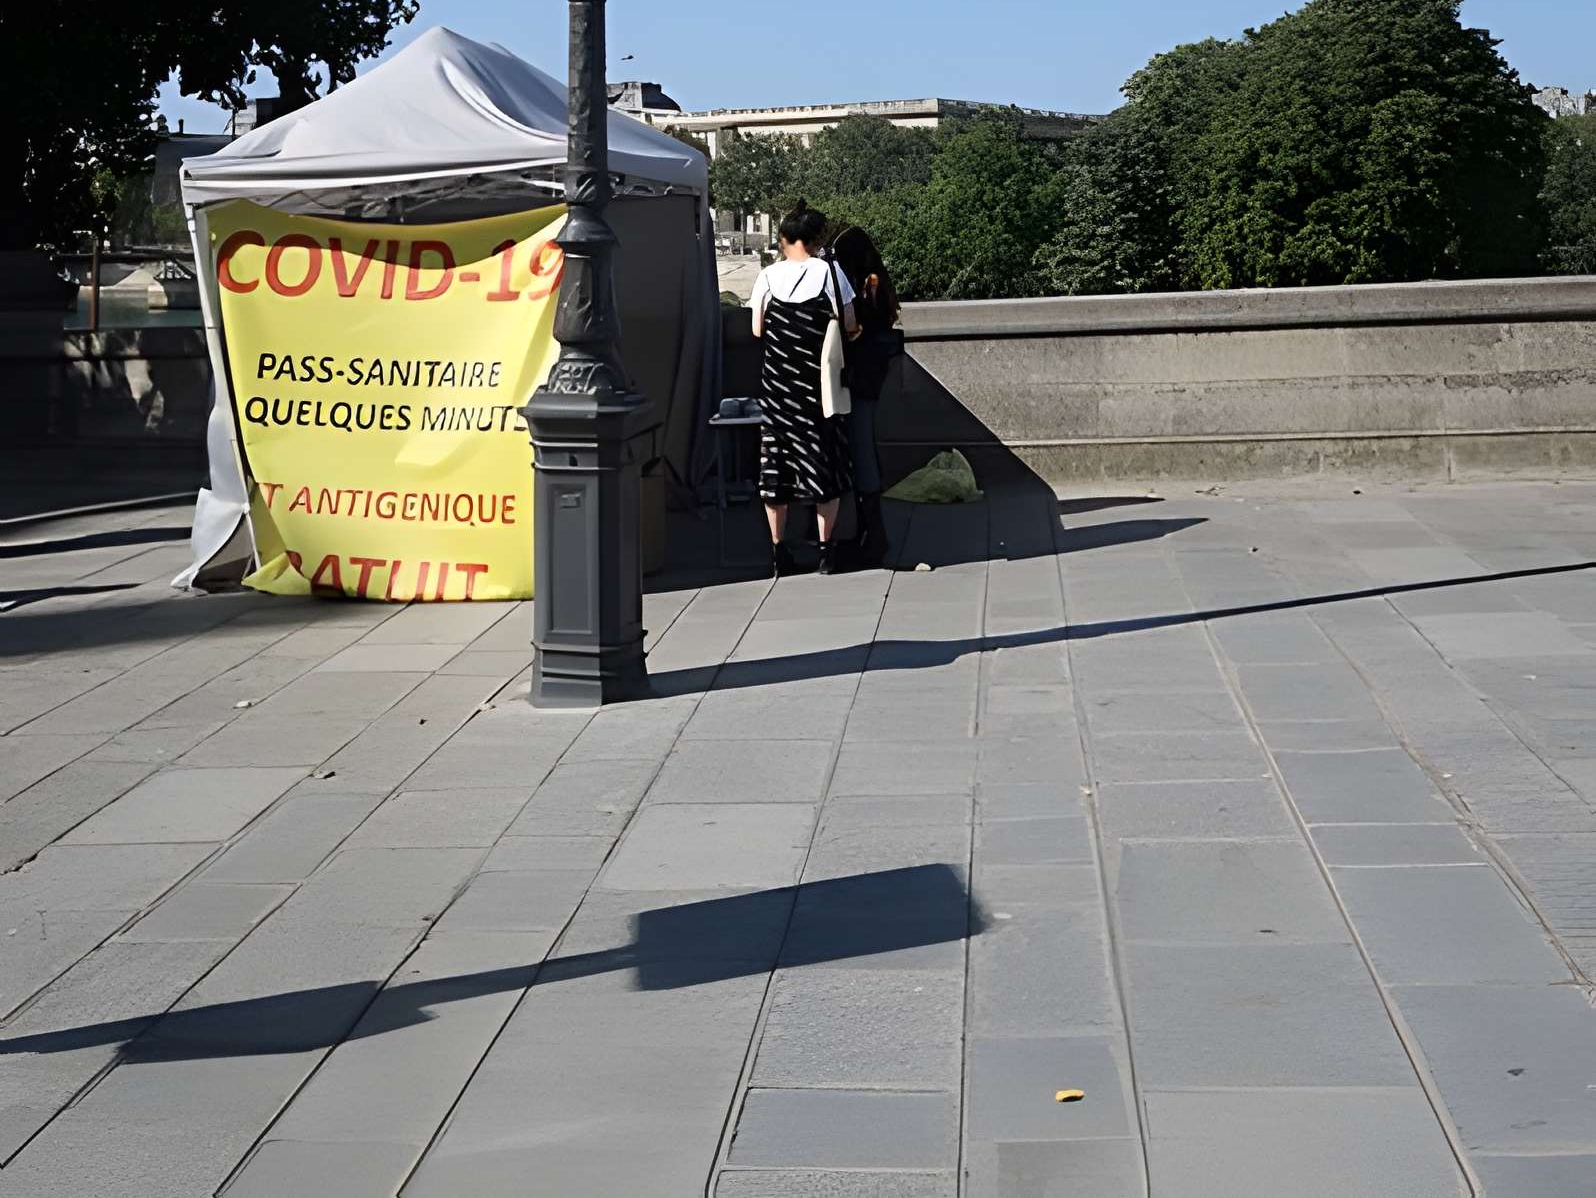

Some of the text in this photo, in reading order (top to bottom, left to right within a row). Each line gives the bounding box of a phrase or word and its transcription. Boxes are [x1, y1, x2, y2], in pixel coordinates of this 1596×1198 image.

[256, 352, 502, 387] PASS-SANITAIRE
[244, 396, 412, 433] QUELQUES
[288, 486, 516, 527] ANTIGENIQUE
